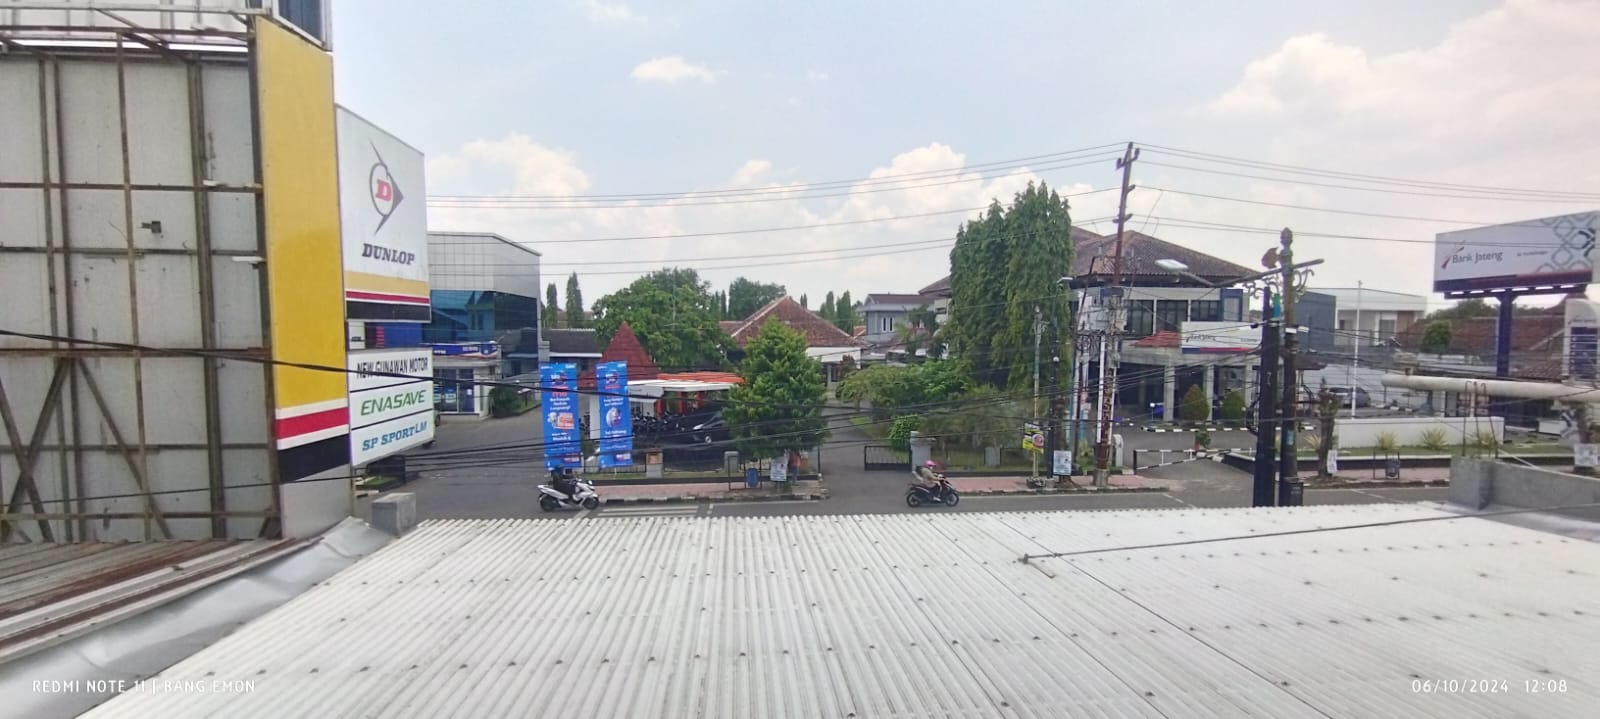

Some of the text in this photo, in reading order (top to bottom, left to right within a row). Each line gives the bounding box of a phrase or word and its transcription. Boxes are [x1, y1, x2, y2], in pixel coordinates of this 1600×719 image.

[361, 242, 416, 266] DUNLOP
[1452, 253, 1473, 264] Bank
[356, 357, 429, 379] NEW GUNAWAN MOTOR
[360, 389, 427, 416] ENASAVE
[362, 436, 379, 452] SP
